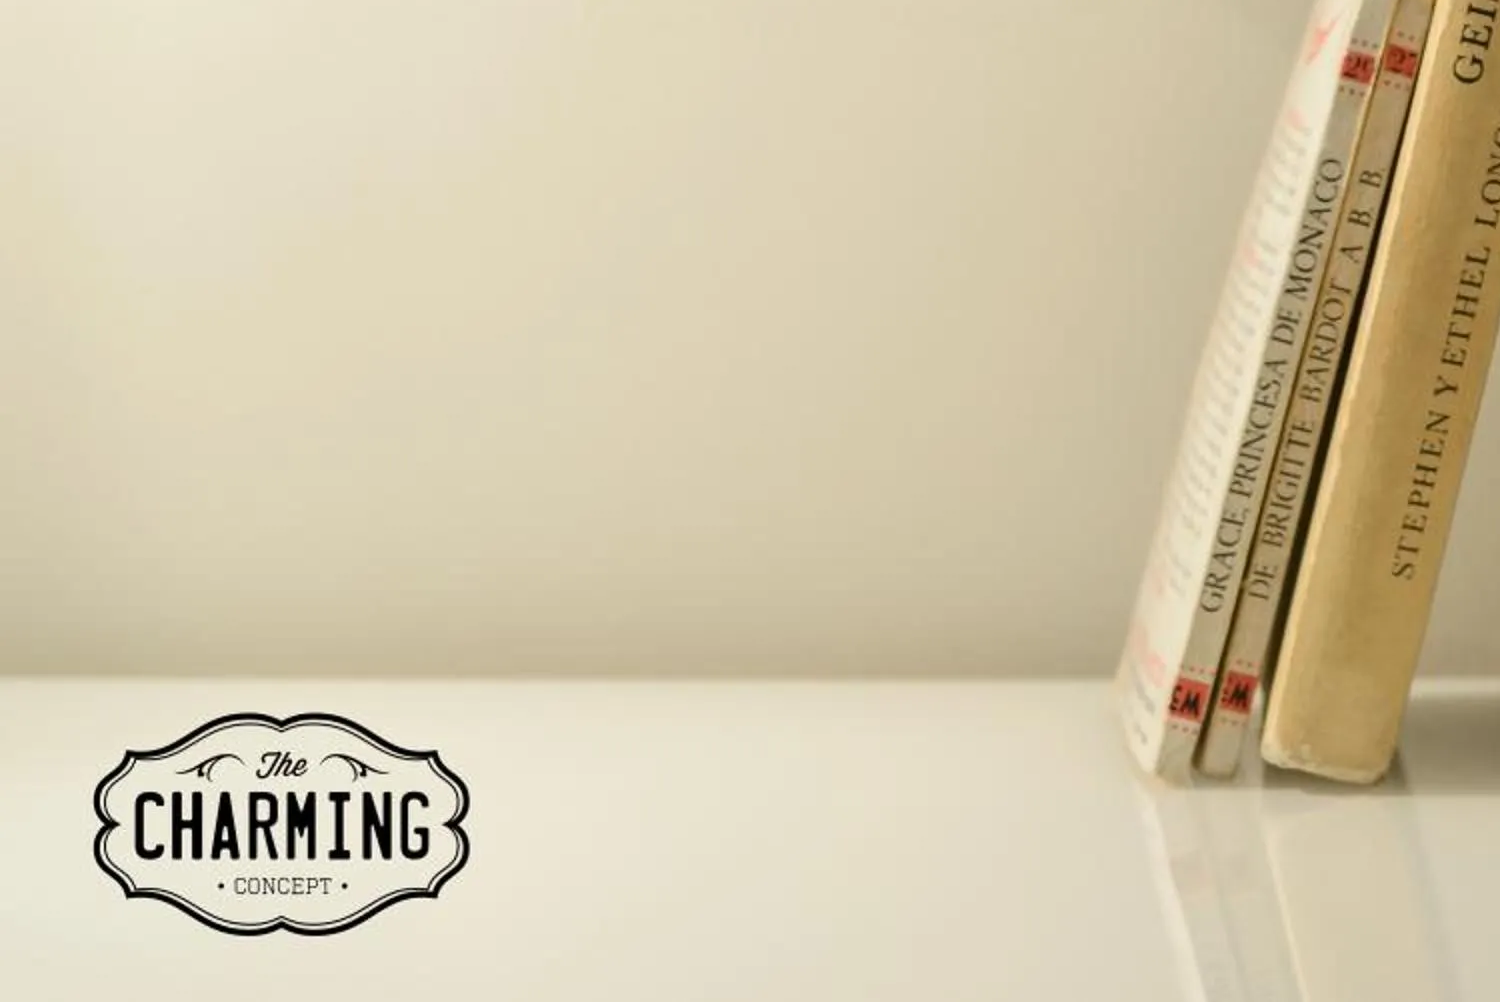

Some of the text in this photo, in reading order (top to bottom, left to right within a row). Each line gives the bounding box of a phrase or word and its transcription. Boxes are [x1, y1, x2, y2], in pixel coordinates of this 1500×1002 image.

[1284, 158, 1344, 301] MONACO
[1339, 243, 1365, 265] A
[1270, 307, 1303, 348] DE
[1299, 277, 1353, 404] BARDOT
[1440, 245, 1492, 369] ETHEL
[1230, 357, 1289, 498] PRINCESA
[1433, 374, 1460, 399] Y
[1261, 419, 1316, 549] BRIGITTE
[1391, 409, 1451, 582] STEPHEN
[1200, 508, 1250, 614] GRACE,
[1248, 562, 1280, 602] DE
